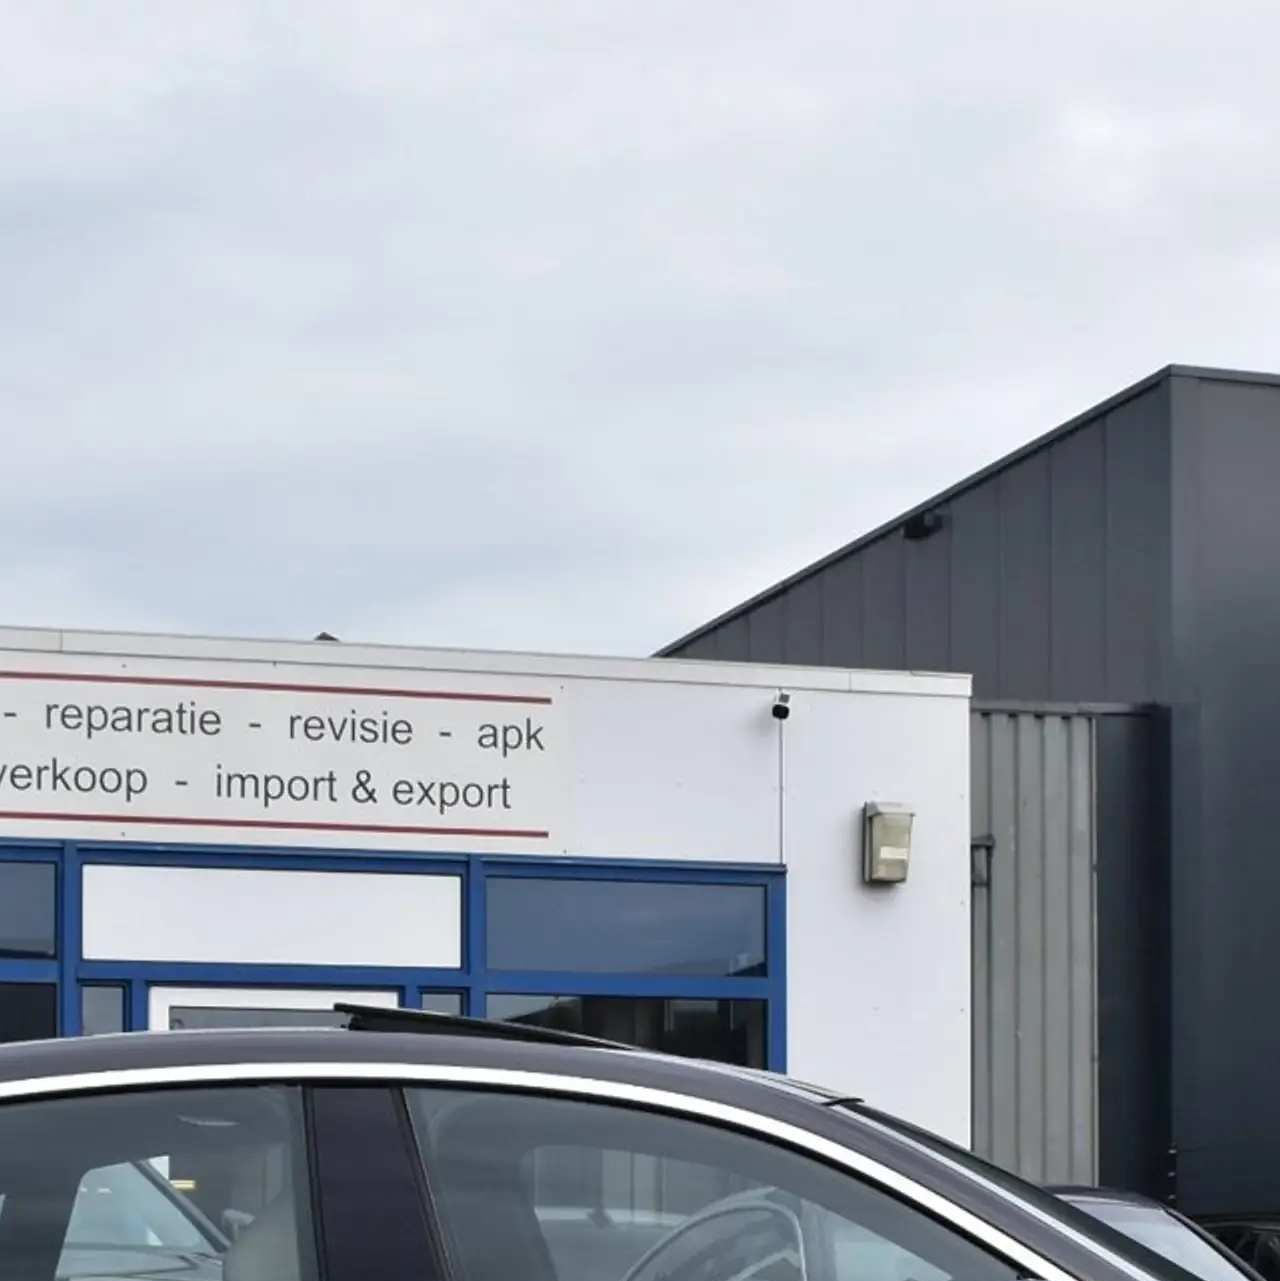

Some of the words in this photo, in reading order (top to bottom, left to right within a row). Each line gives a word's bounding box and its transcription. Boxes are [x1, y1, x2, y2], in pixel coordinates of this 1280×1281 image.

[46, 702, 222, 740] reparatie
[289, 711, 414, 745] revisie
[477, 718, 545, 758] apk
[215, 763, 338, 808] import
[351, 769, 378, 804] &
[392, 774, 513, 815] export
